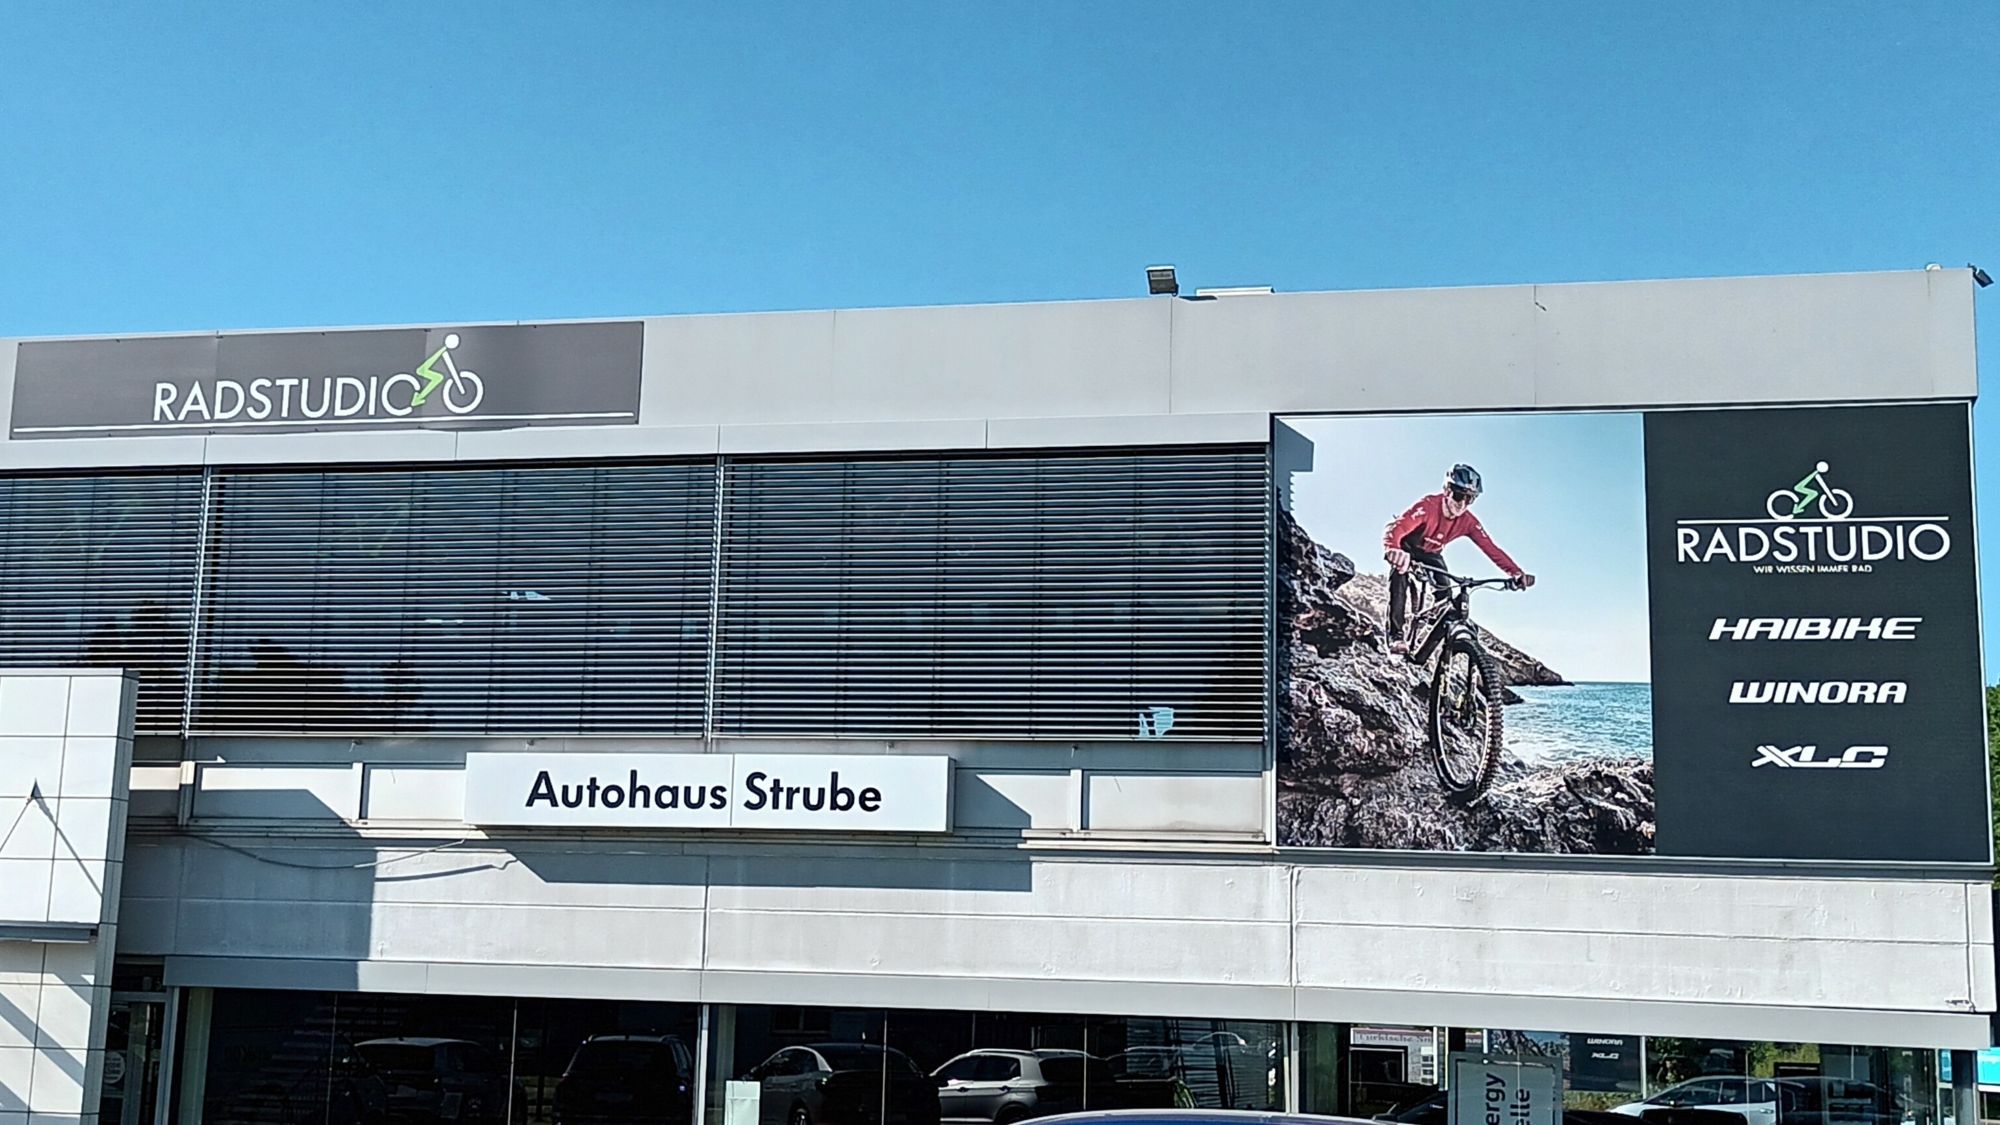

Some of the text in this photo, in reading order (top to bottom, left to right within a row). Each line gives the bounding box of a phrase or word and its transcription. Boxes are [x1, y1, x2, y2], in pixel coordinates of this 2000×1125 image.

[153, 374, 420, 421] RADSTUDIO
[1677, 523, 1950, 562] RADSTUDIO
[1753, 565, 1773, 573] WIR
[1776, 565, 1815, 573] WISSEN
[1708, 617, 1923, 640] HAIBIKE
[1729, 681, 1907, 704] WINORA
[1751, 745, 1889, 768] XLC
[525, 769, 882, 812] Autohaus Strube
